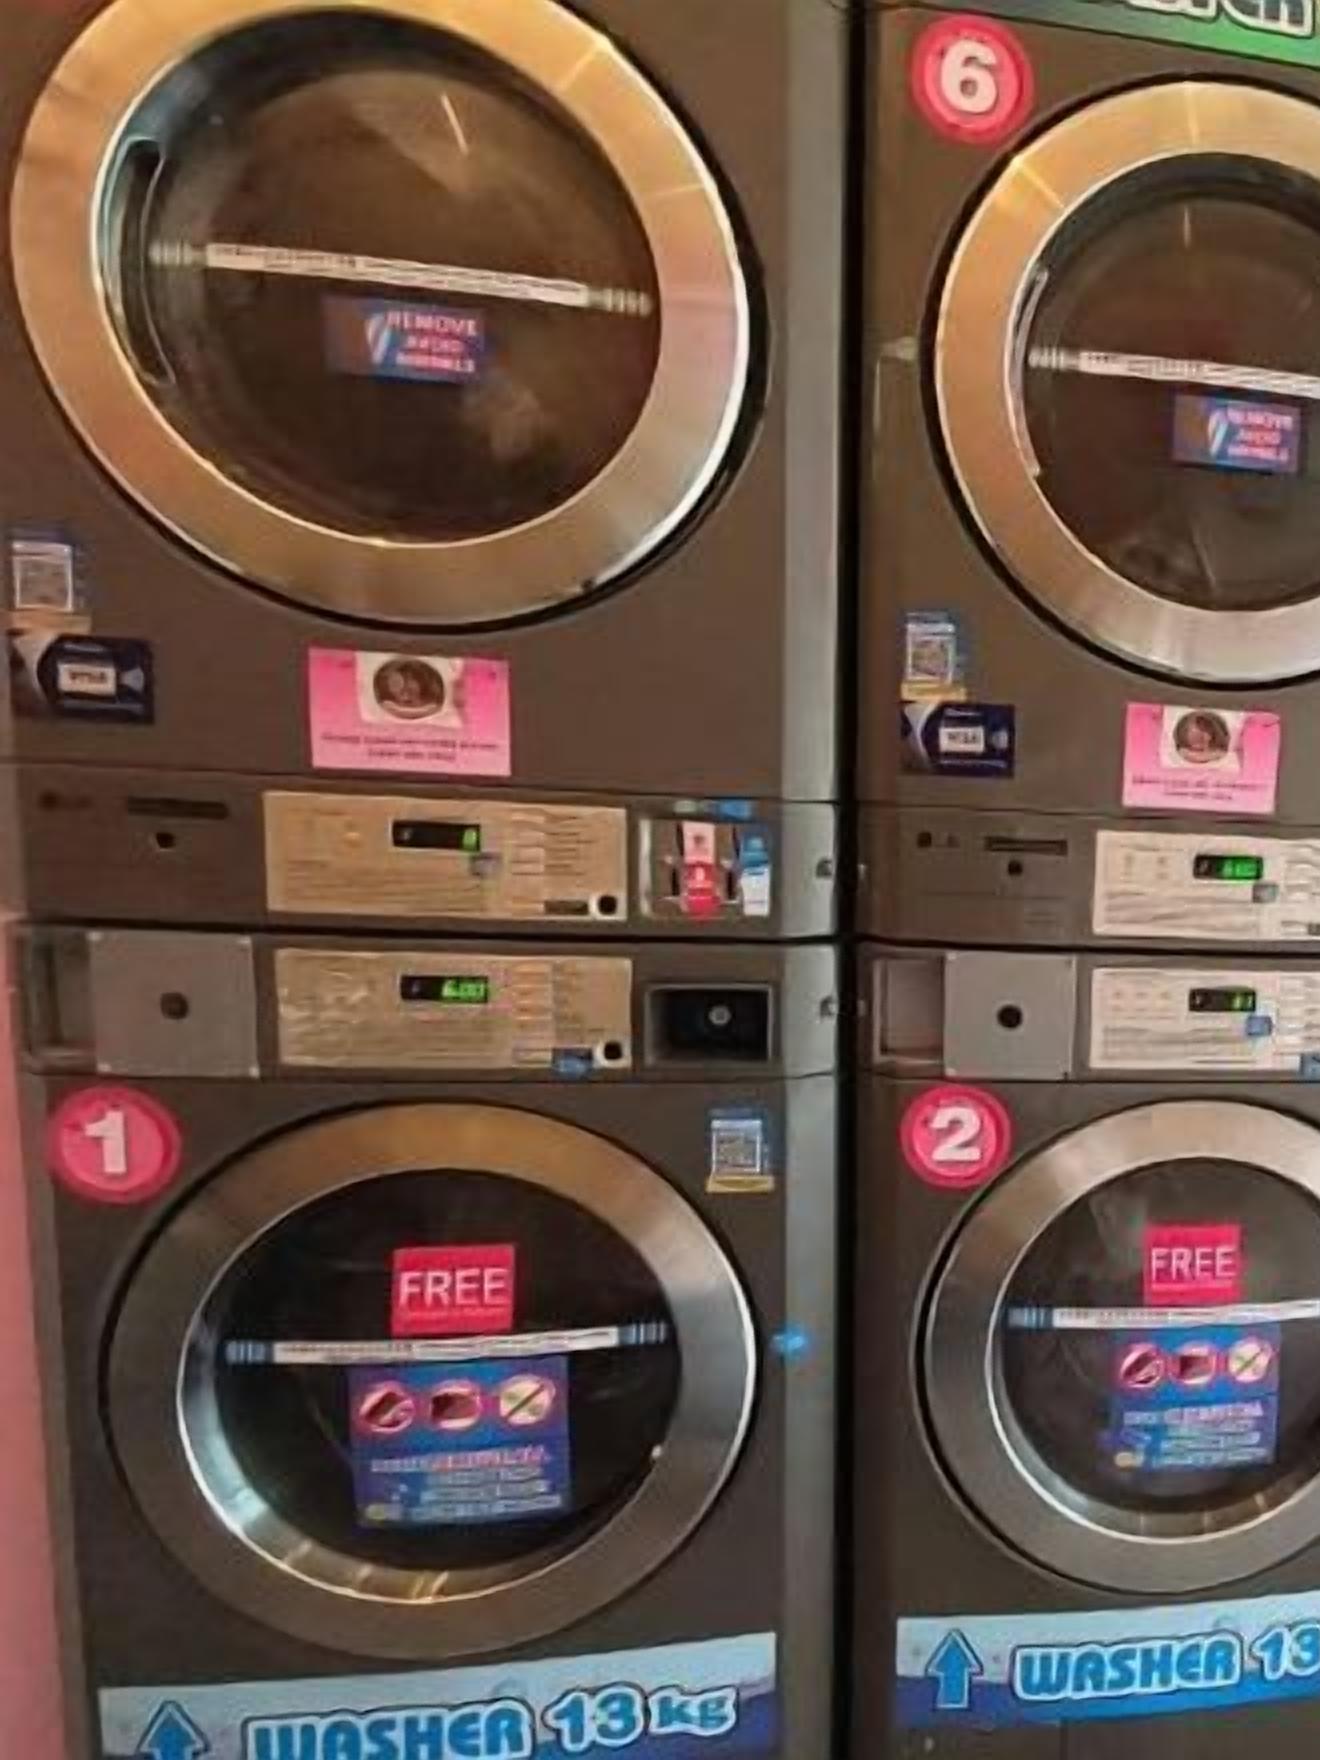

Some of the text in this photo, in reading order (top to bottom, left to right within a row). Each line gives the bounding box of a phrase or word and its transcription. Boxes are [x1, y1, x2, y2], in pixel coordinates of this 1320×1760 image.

[940, 39, 998, 114] 6
[84, 1109, 127, 1174] 1
[929, 1105, 981, 1162] 2
[399, 1267, 509, 1307] FREE
[1151, 1246, 1237, 1280] FREE
[1018, 1637, 1238, 1698] WASHER
[251, 1704, 527, 1760] WASHER
